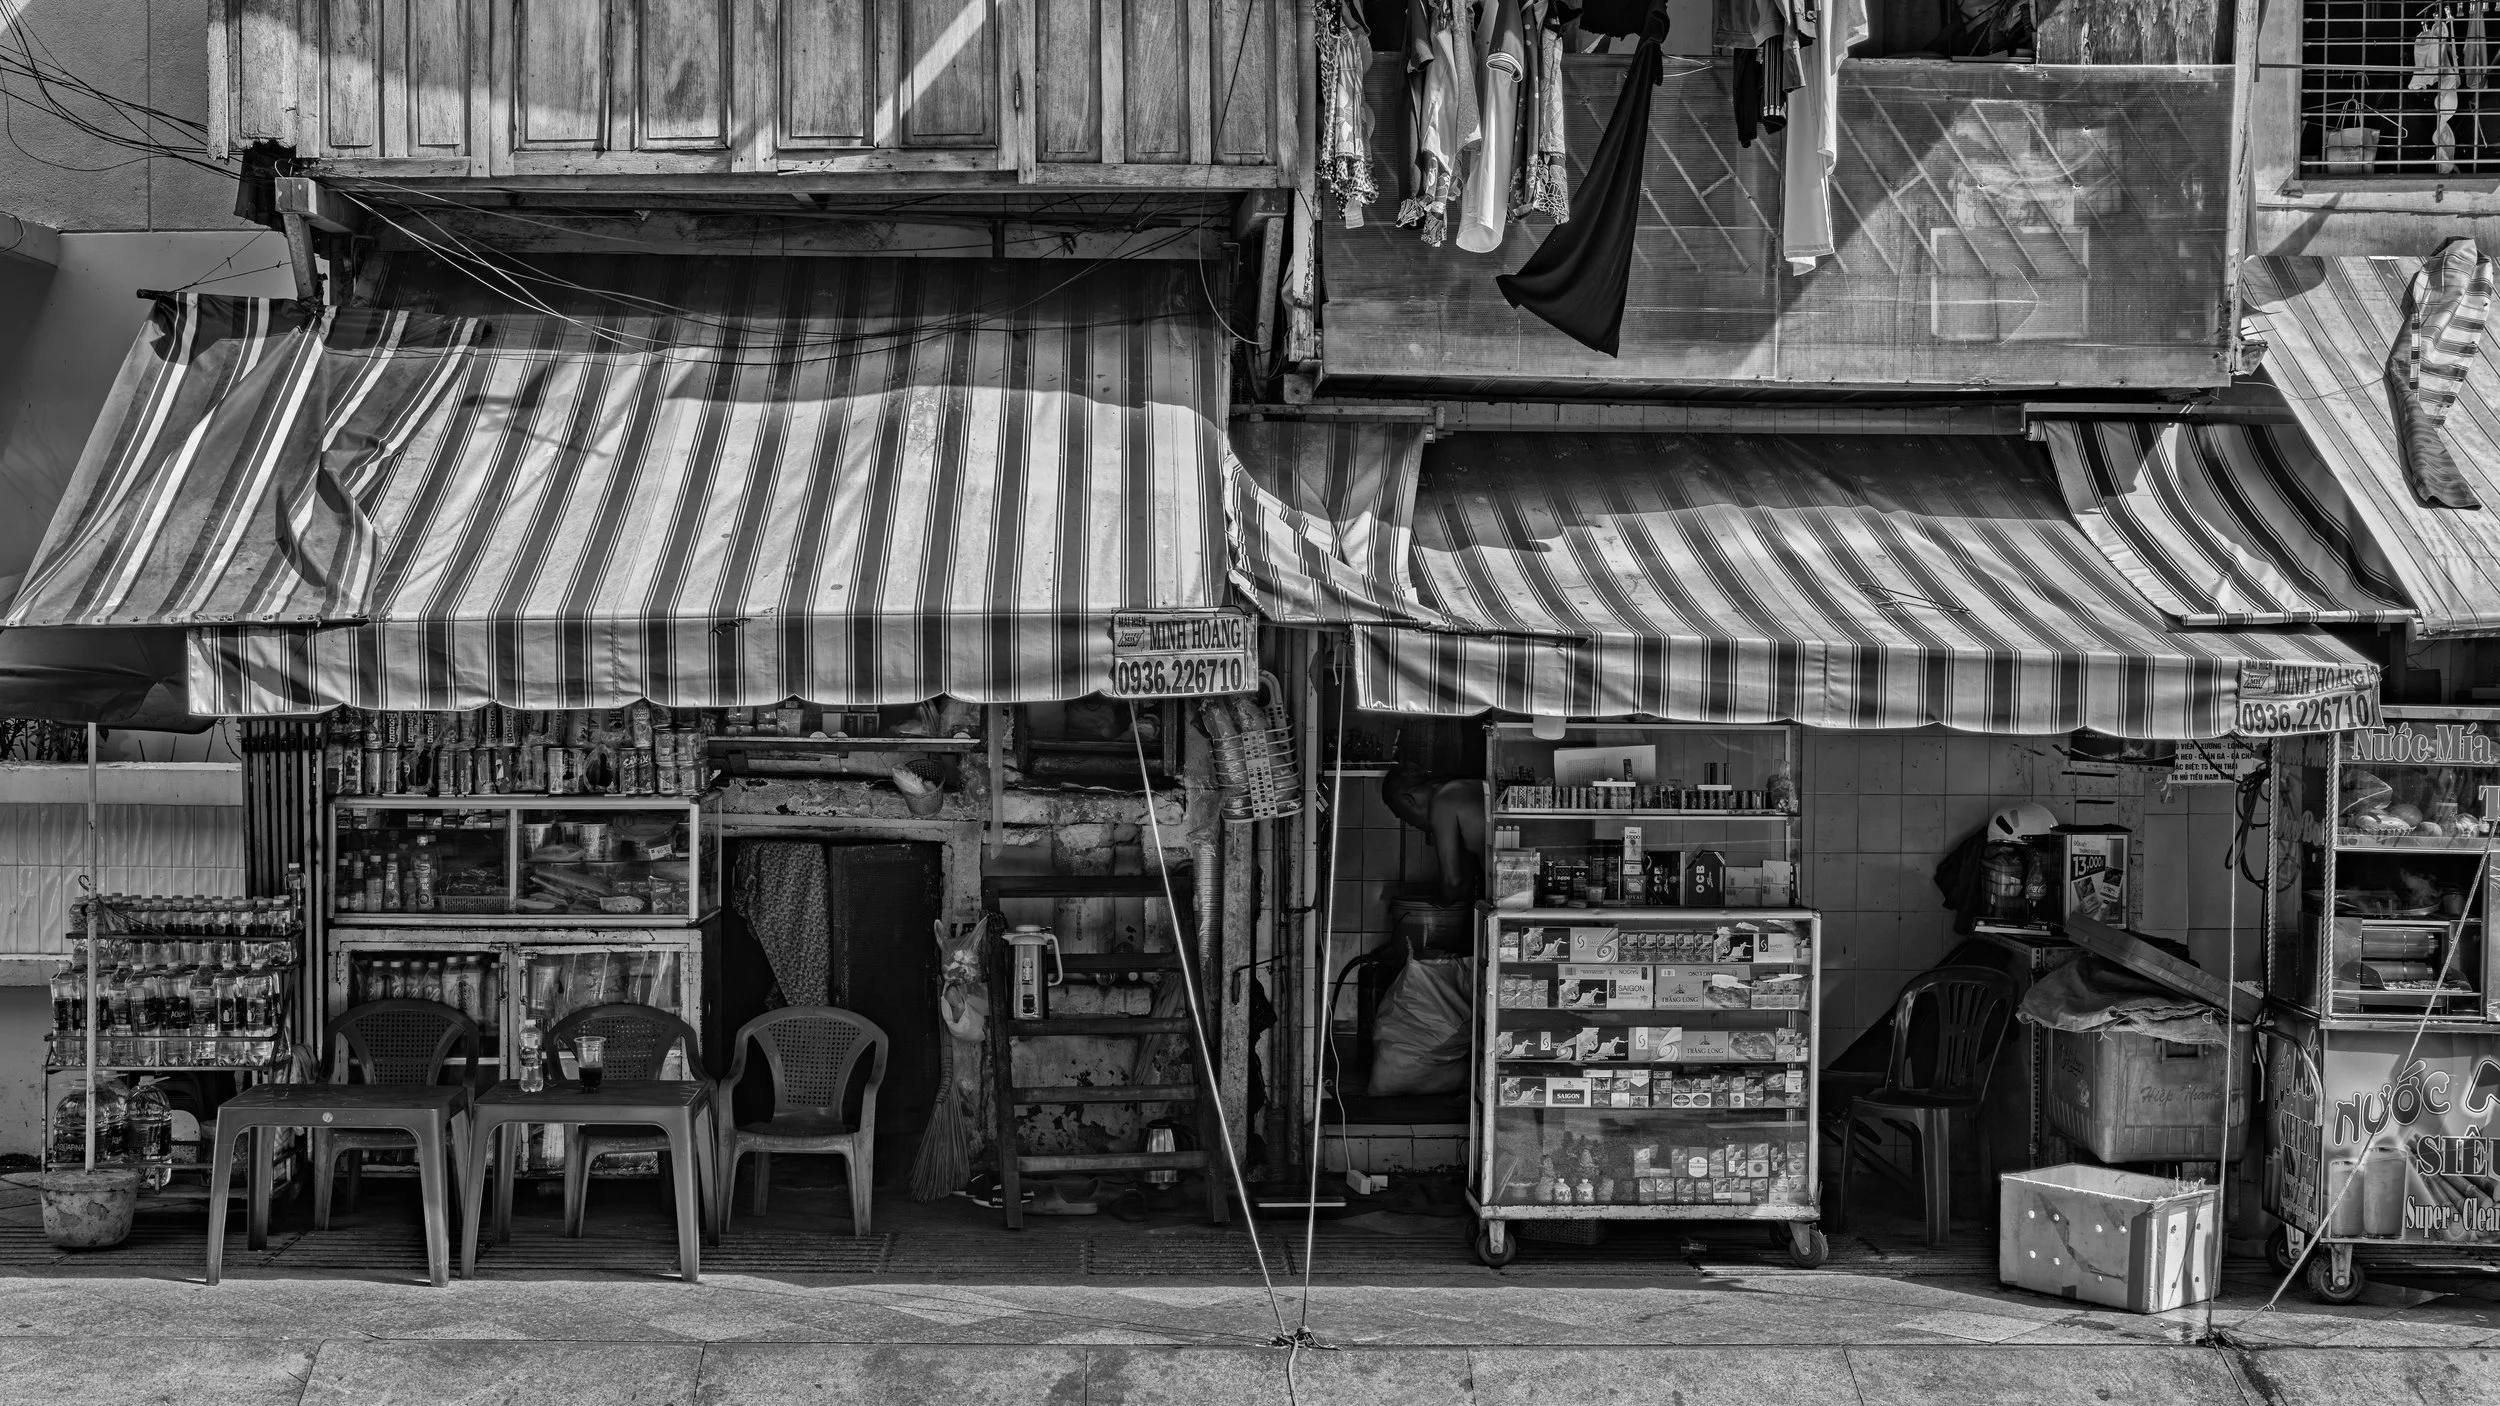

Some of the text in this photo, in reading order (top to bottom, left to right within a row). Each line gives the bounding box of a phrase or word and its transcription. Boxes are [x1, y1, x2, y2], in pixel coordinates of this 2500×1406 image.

[1149, 620, 1187, 650] MINH
[1118, 658, 1242, 695] 0936.226710
[2274, 665, 2312, 695] MINH
[2243, 694, 2369, 735] 0936.226710
[2352, 722, 2428, 763] Nước
[2435, 722, 2491, 763] Mía
[1695, 865, 1705, 894] OCB
[1617, 984, 1645, 992] SAIGON
[2334, 1060, 2450, 1146] NƯỚC
[2406, 1195, 2450, 1239] Super
